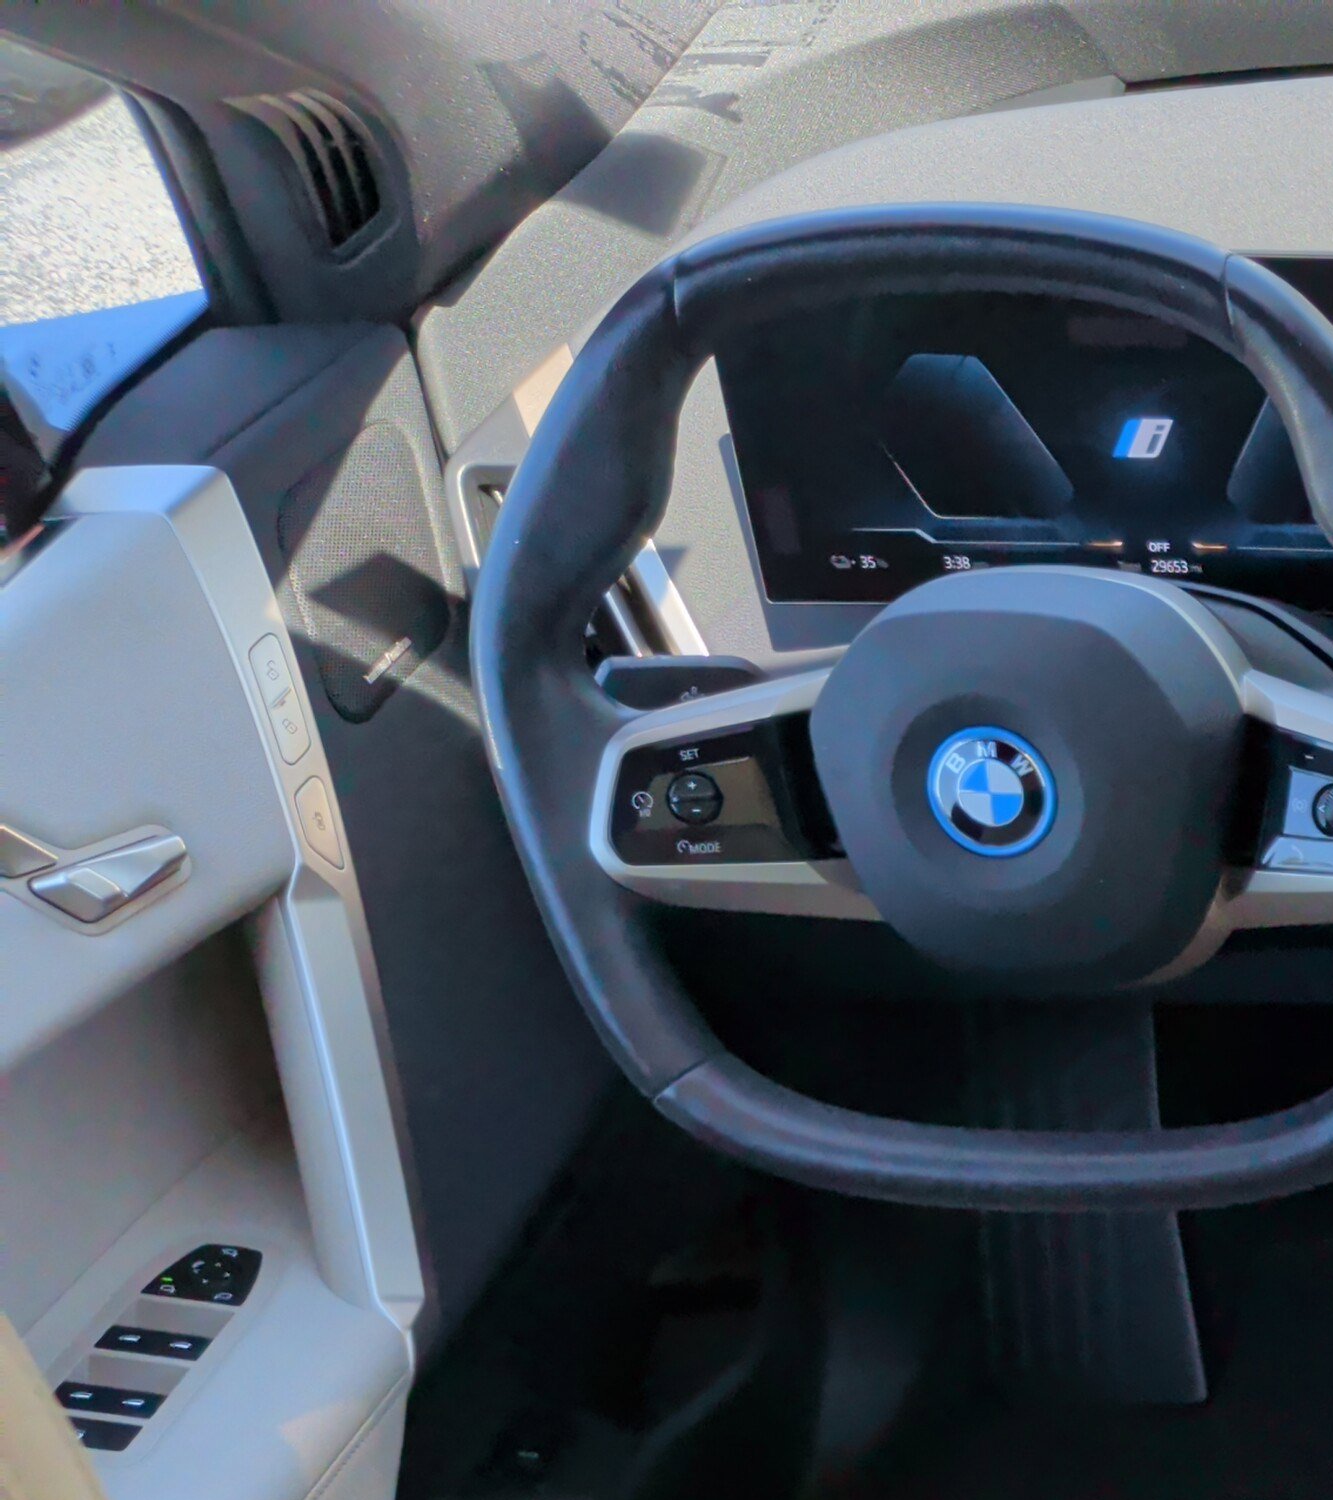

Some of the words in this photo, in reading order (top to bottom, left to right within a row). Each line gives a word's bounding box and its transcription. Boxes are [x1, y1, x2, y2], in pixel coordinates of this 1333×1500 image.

[1148, 542, 1171, 553] OFF
[942, 556, 972, 570] 3:38
[1151, 560, 1189, 574] 29653
[679, 748, 700, 761] SET
[945, 740, 1035, 778] BMW
[689, 842, 722, 855] MODE
